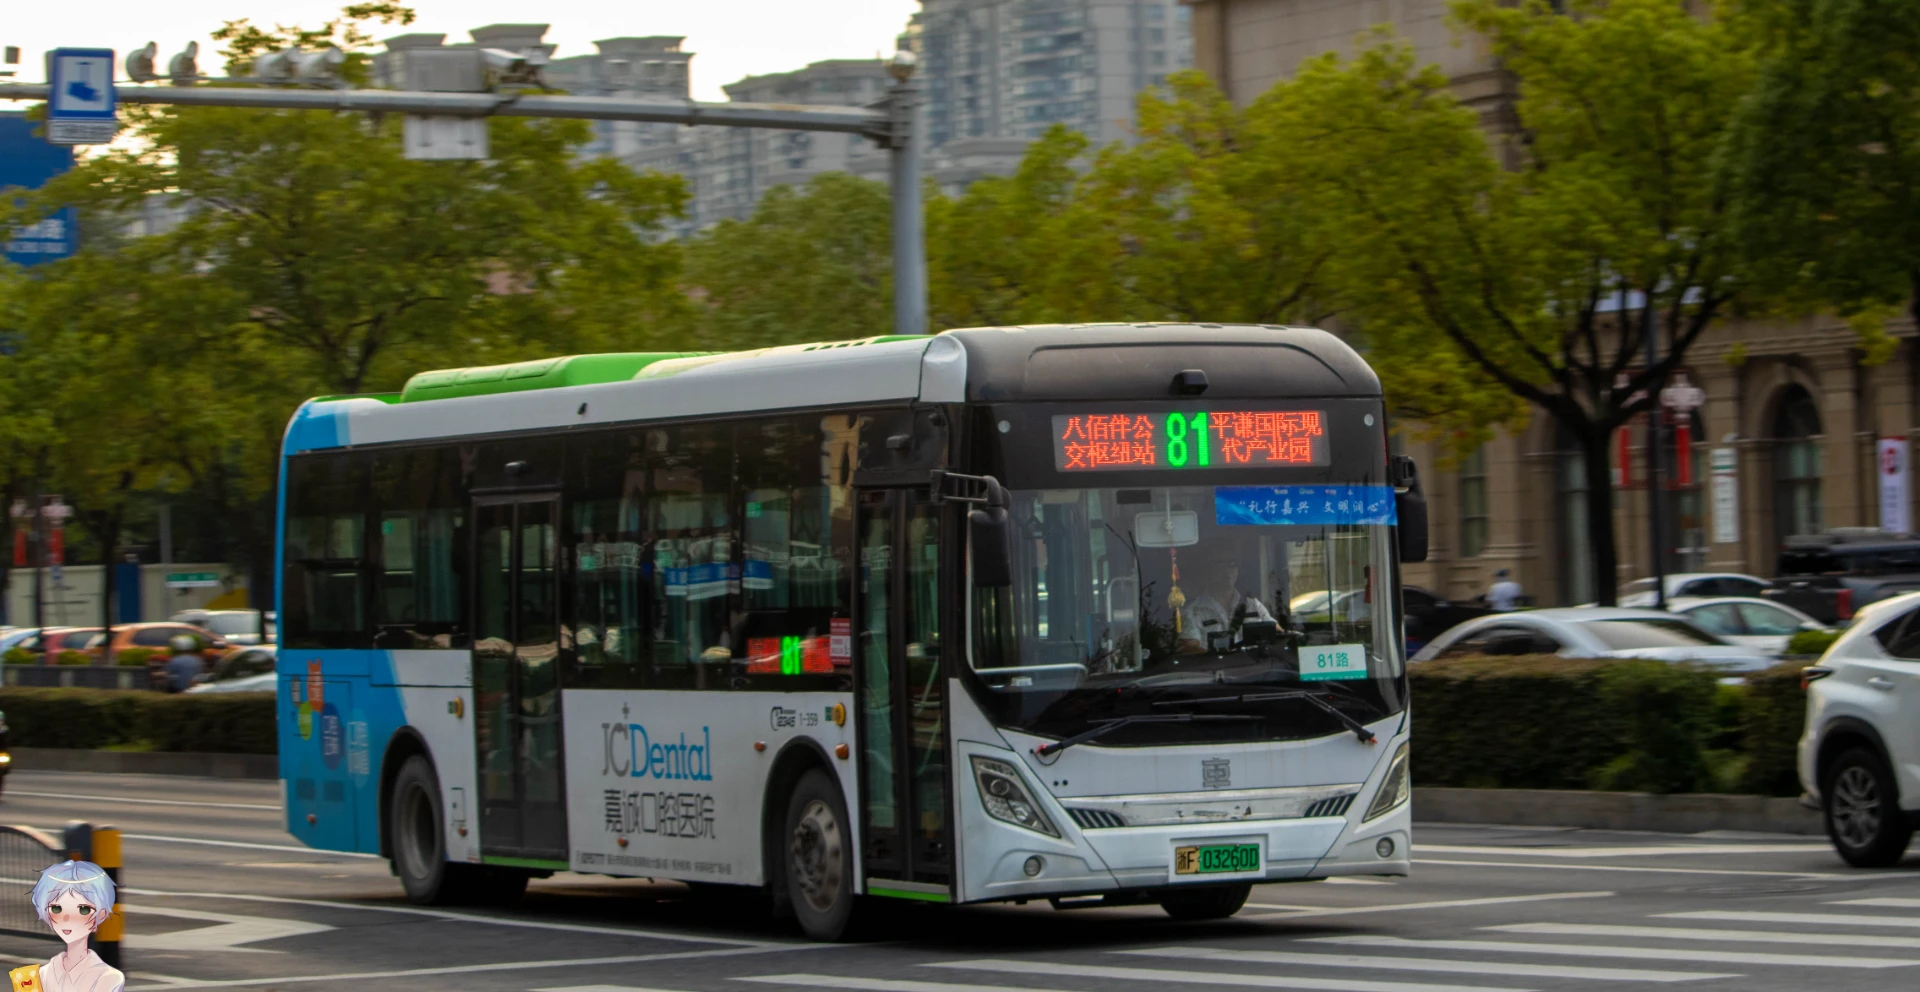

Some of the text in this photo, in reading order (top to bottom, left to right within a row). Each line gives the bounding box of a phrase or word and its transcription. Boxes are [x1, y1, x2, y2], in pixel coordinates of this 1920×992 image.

[1166, 412, 1210, 467] 81
[1208, 411, 1323, 439] 平谦国际现
[1064, 440, 1156, 469] 交枢纽站
[1221, 437, 1311, 463] 代产业园
[781, 636, 800, 675] 81
[1317, 652, 1349, 668] 81路
[604, 789, 716, 839] 嘉诚口腔医院
